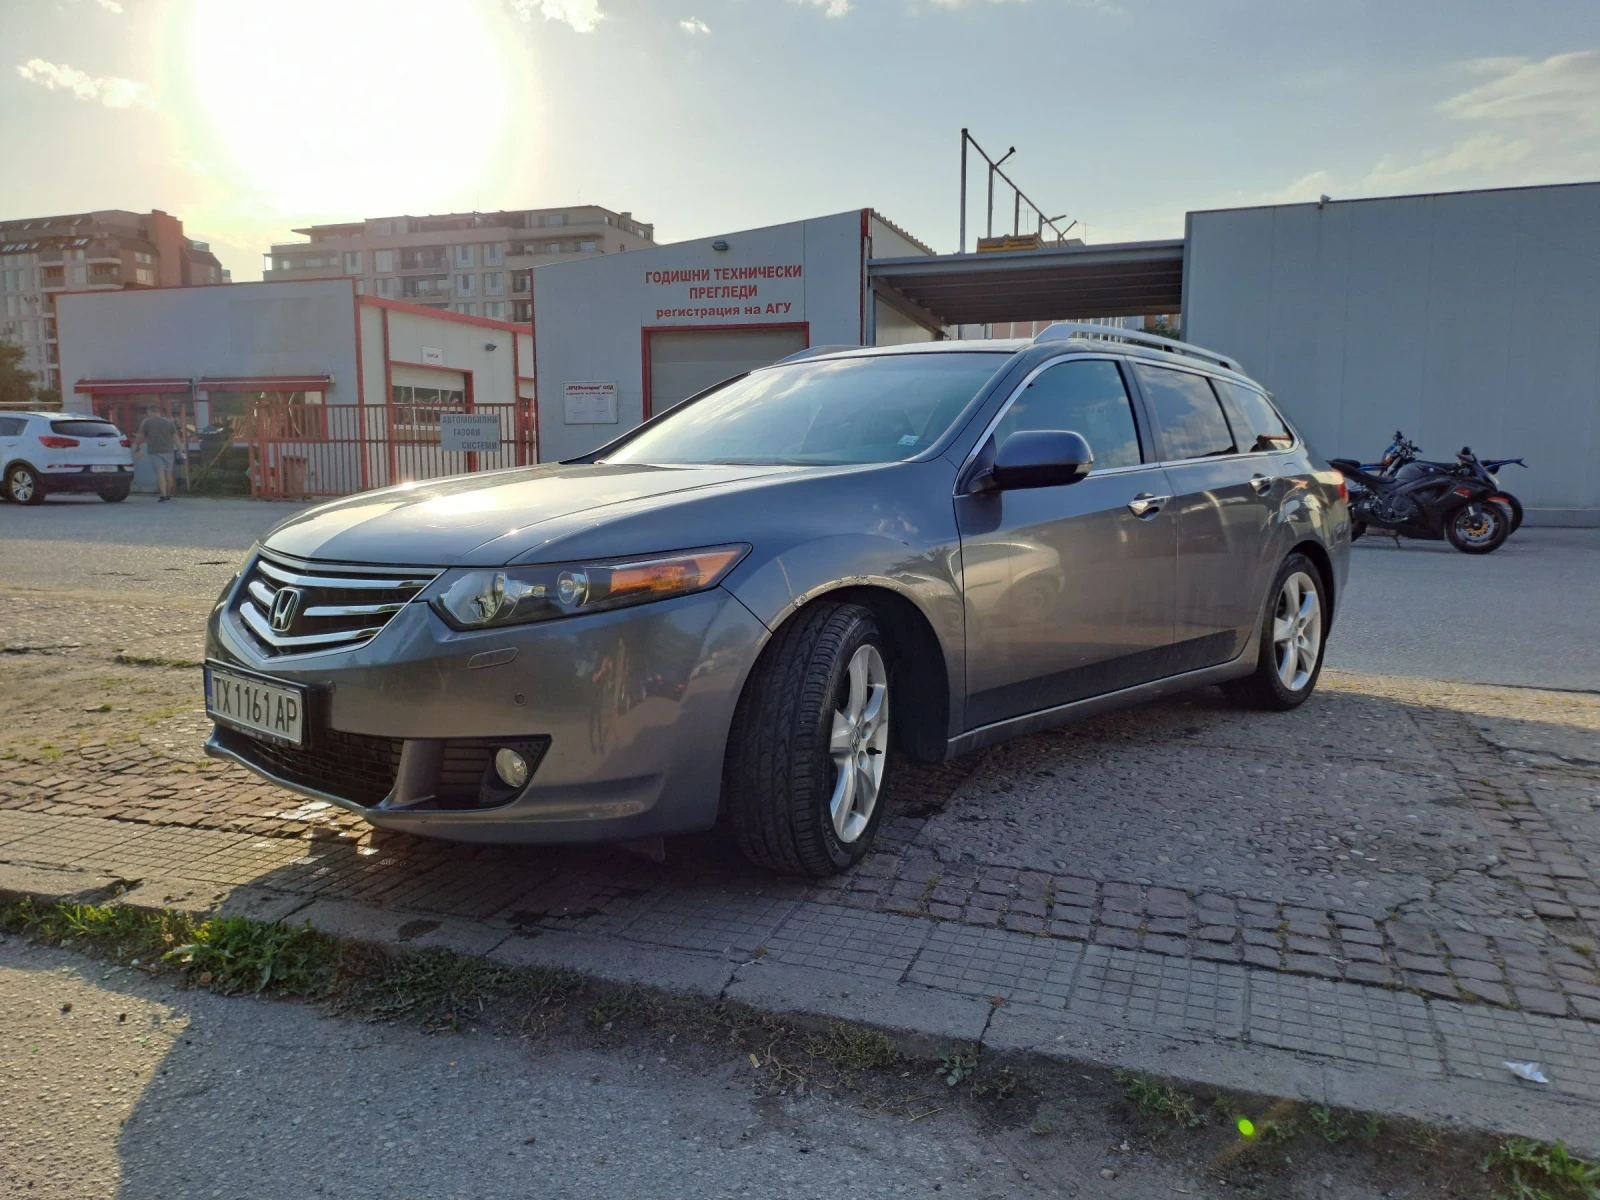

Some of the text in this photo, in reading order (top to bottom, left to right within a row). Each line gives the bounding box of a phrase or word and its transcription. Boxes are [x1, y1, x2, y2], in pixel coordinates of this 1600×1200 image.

[645, 265, 802, 285] ГОДИШНИ ТЕХНИЧЕСКИ
[689, 285, 758, 300] ПРЕГЛЕДИ
[656, 302, 791, 320] регистрация на АГУ
[442, 416, 498, 424] АВТОМОБИЛНИ
[453, 428, 481, 437] ГАЗОВИ
[461, 441, 498, 450] СИСТЕМИ
